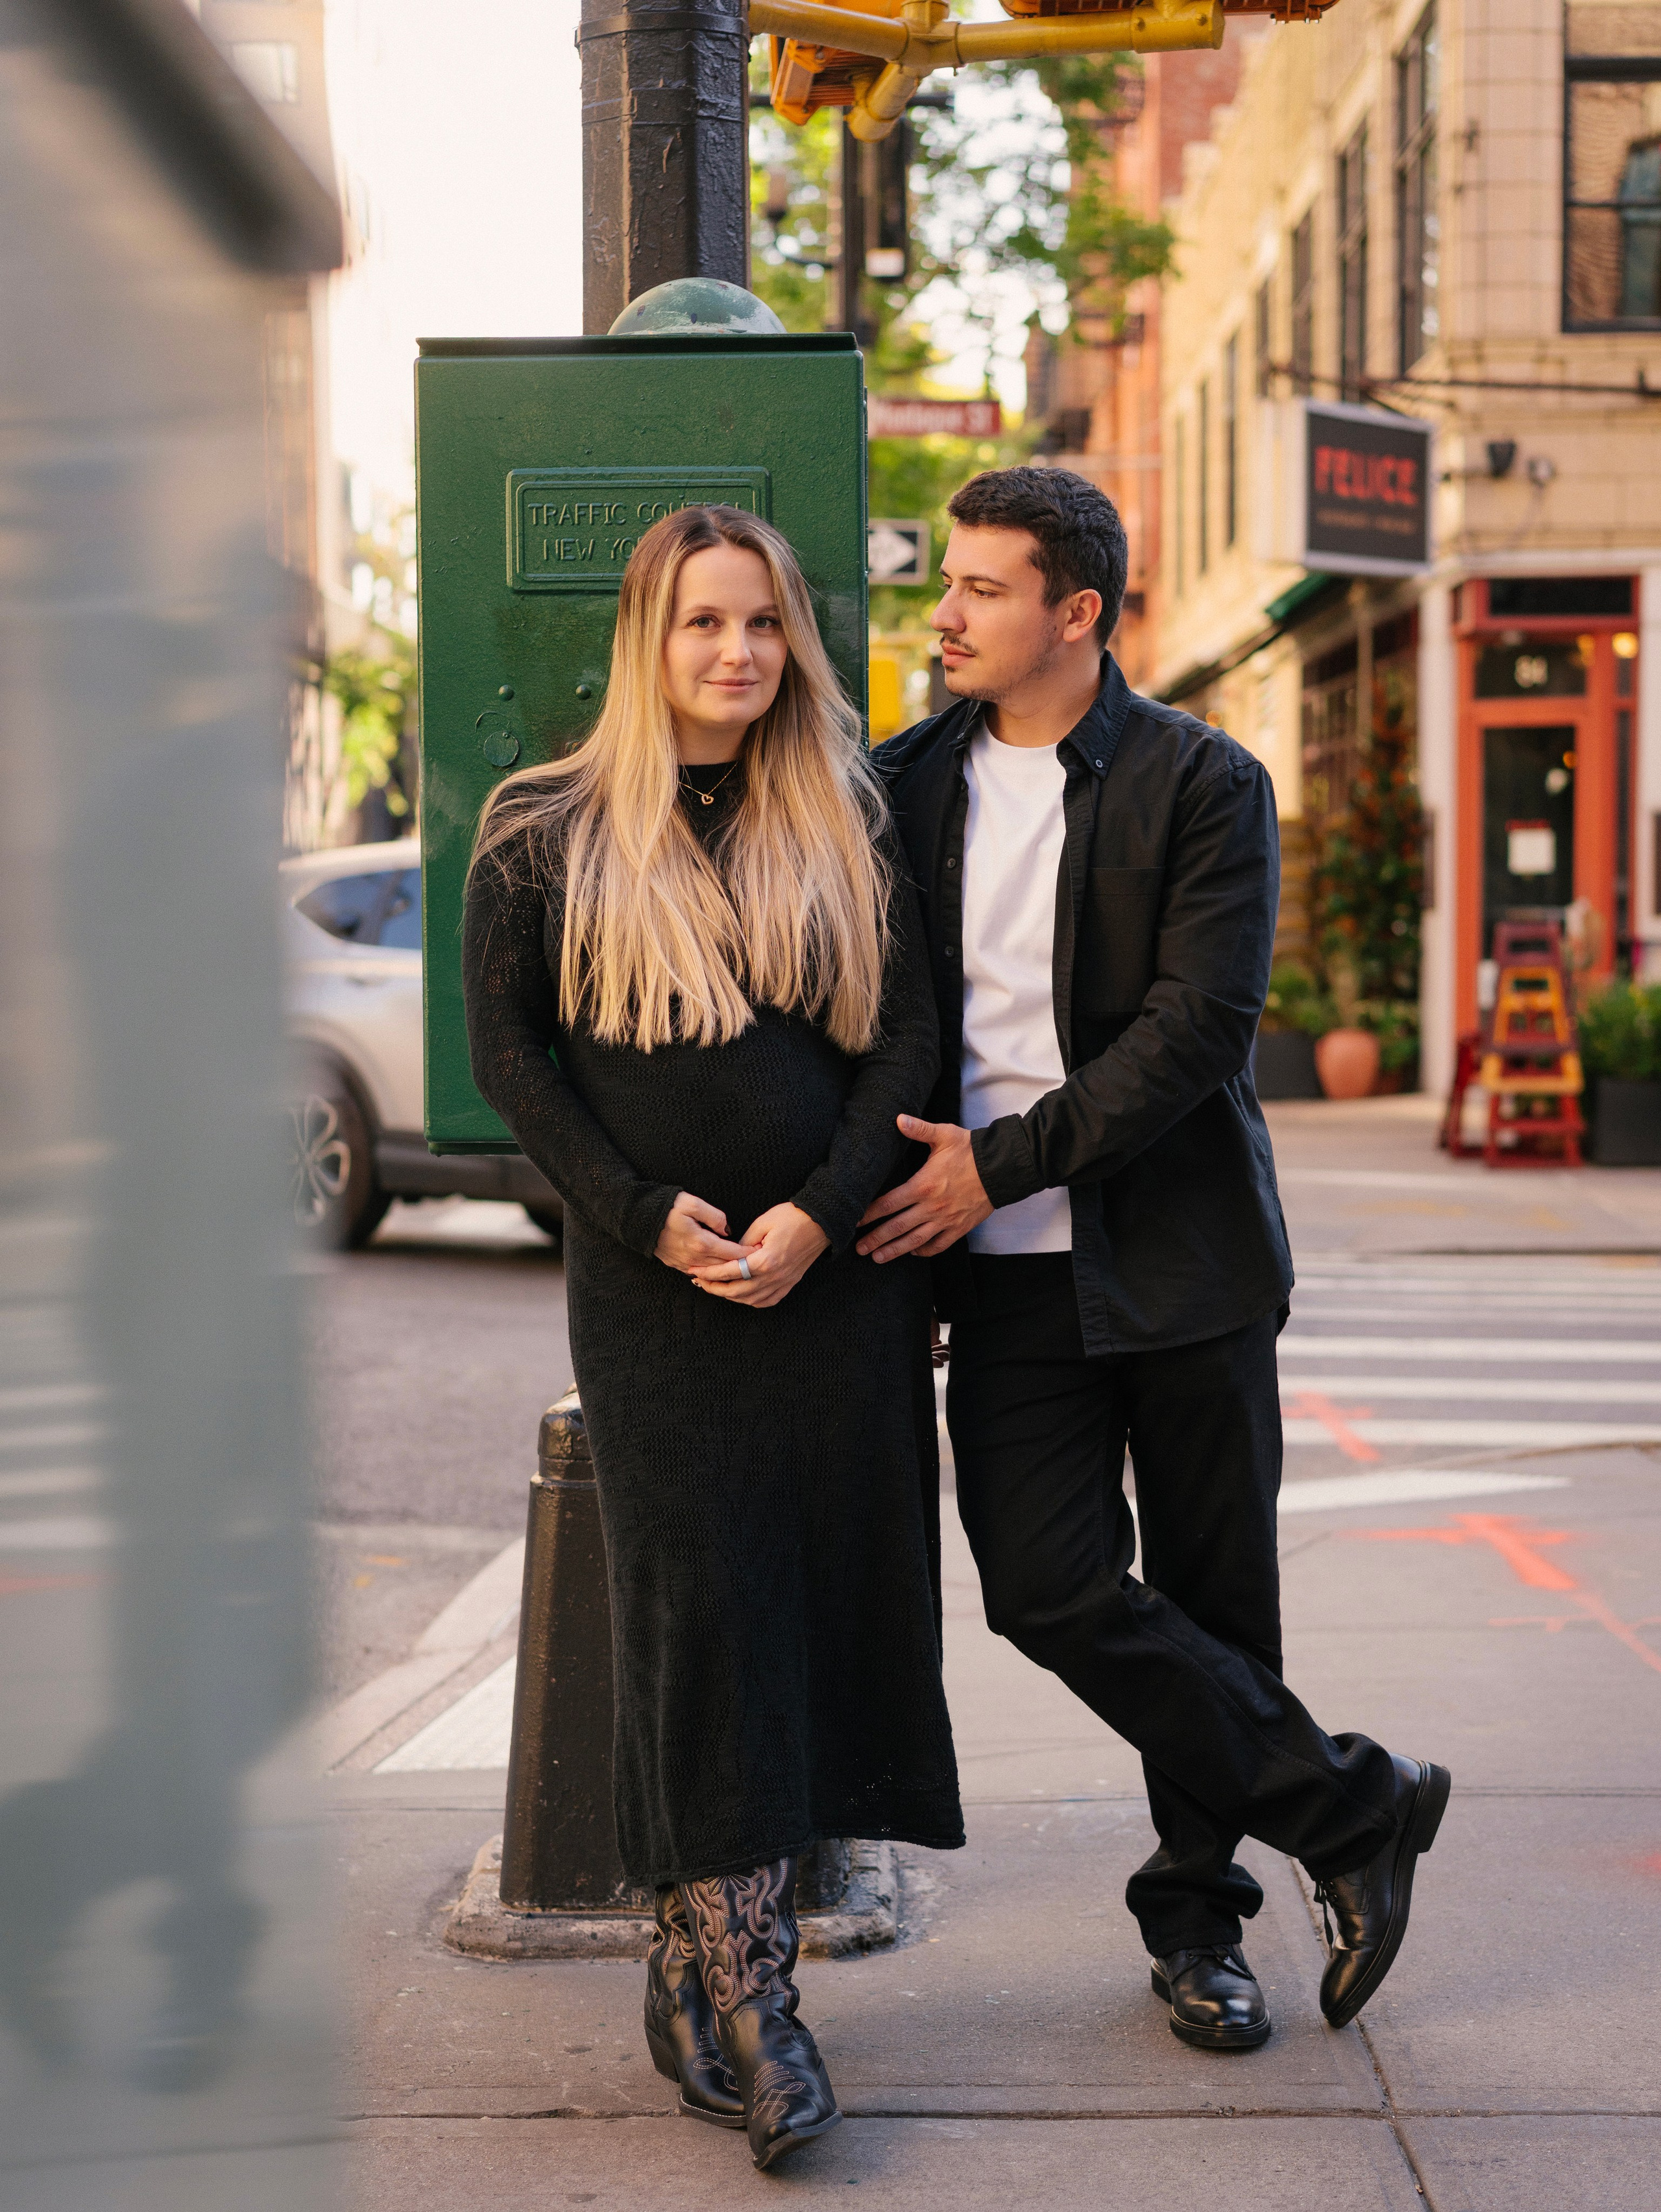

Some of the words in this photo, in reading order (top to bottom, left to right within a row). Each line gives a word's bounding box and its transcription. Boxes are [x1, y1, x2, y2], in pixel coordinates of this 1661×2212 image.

[527, 501, 627, 526] TRAFFIC
[543, 537, 596, 561] NEW
[605, 536, 642, 560] YO
